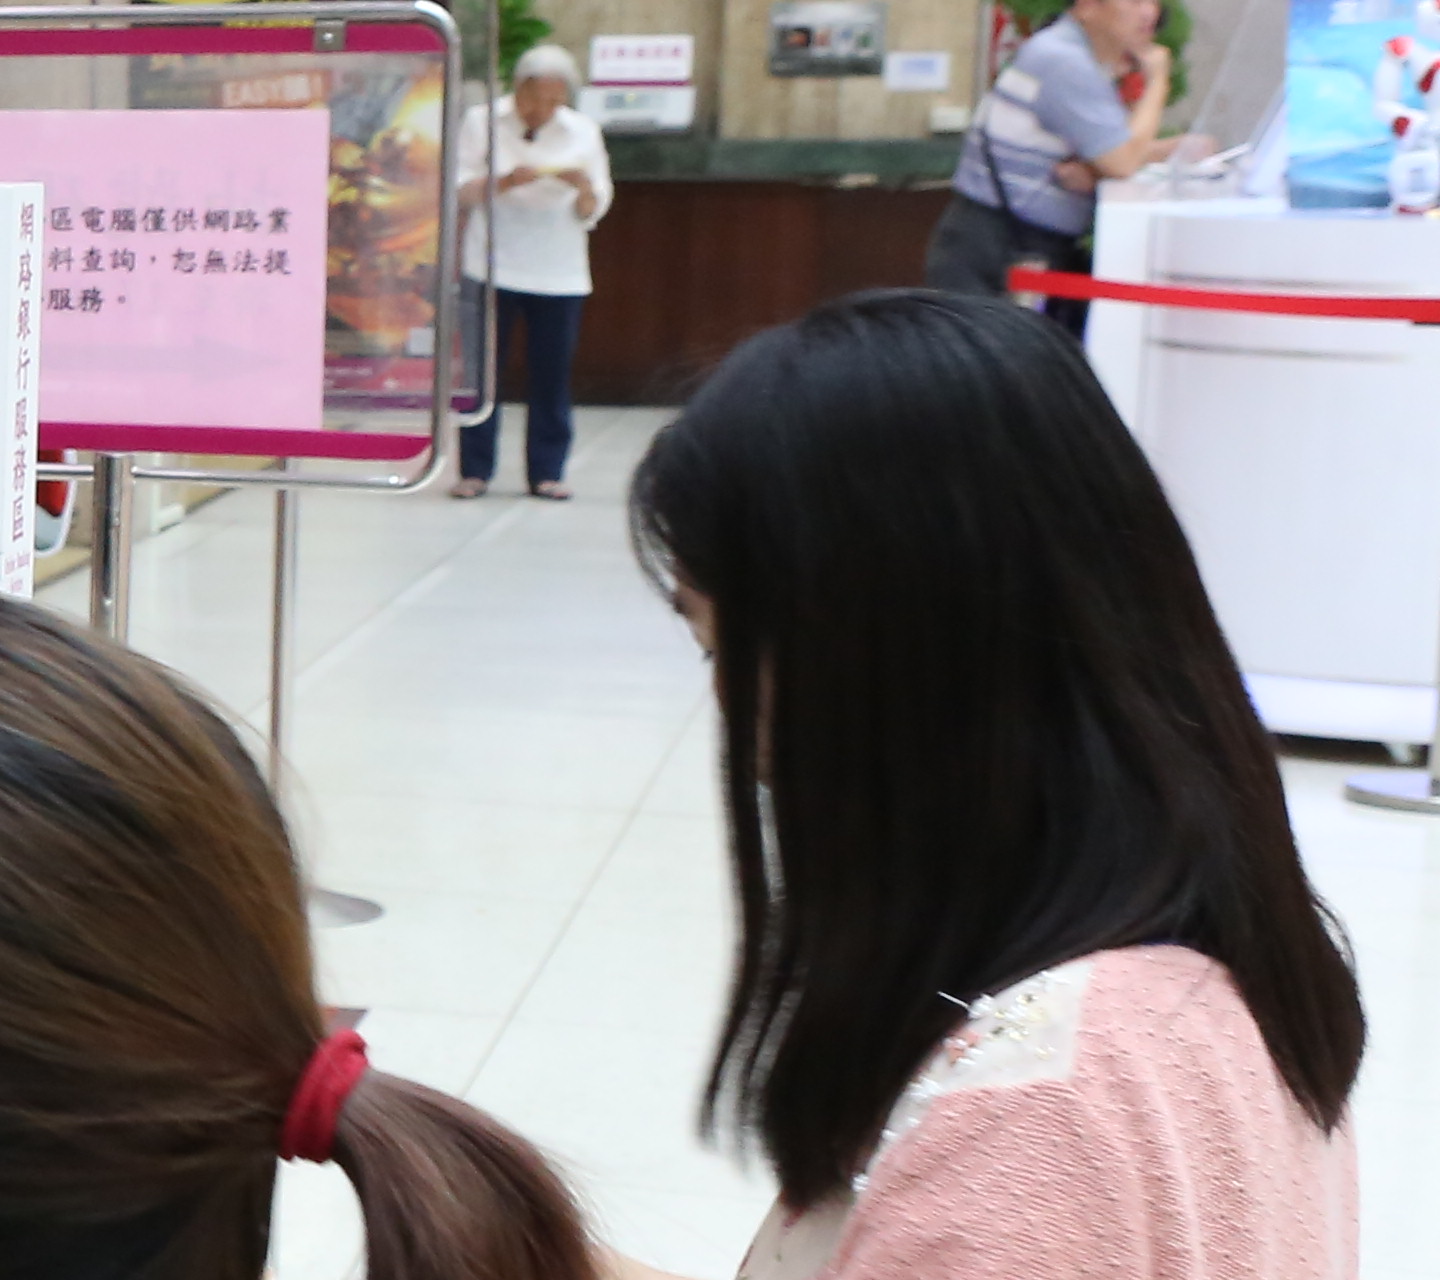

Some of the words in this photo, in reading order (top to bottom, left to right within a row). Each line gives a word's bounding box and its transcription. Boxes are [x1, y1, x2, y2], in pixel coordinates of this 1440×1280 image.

[43, 206, 292, 234] 區電腦僅供網路業
[41, 286, 126, 313] 服務。
